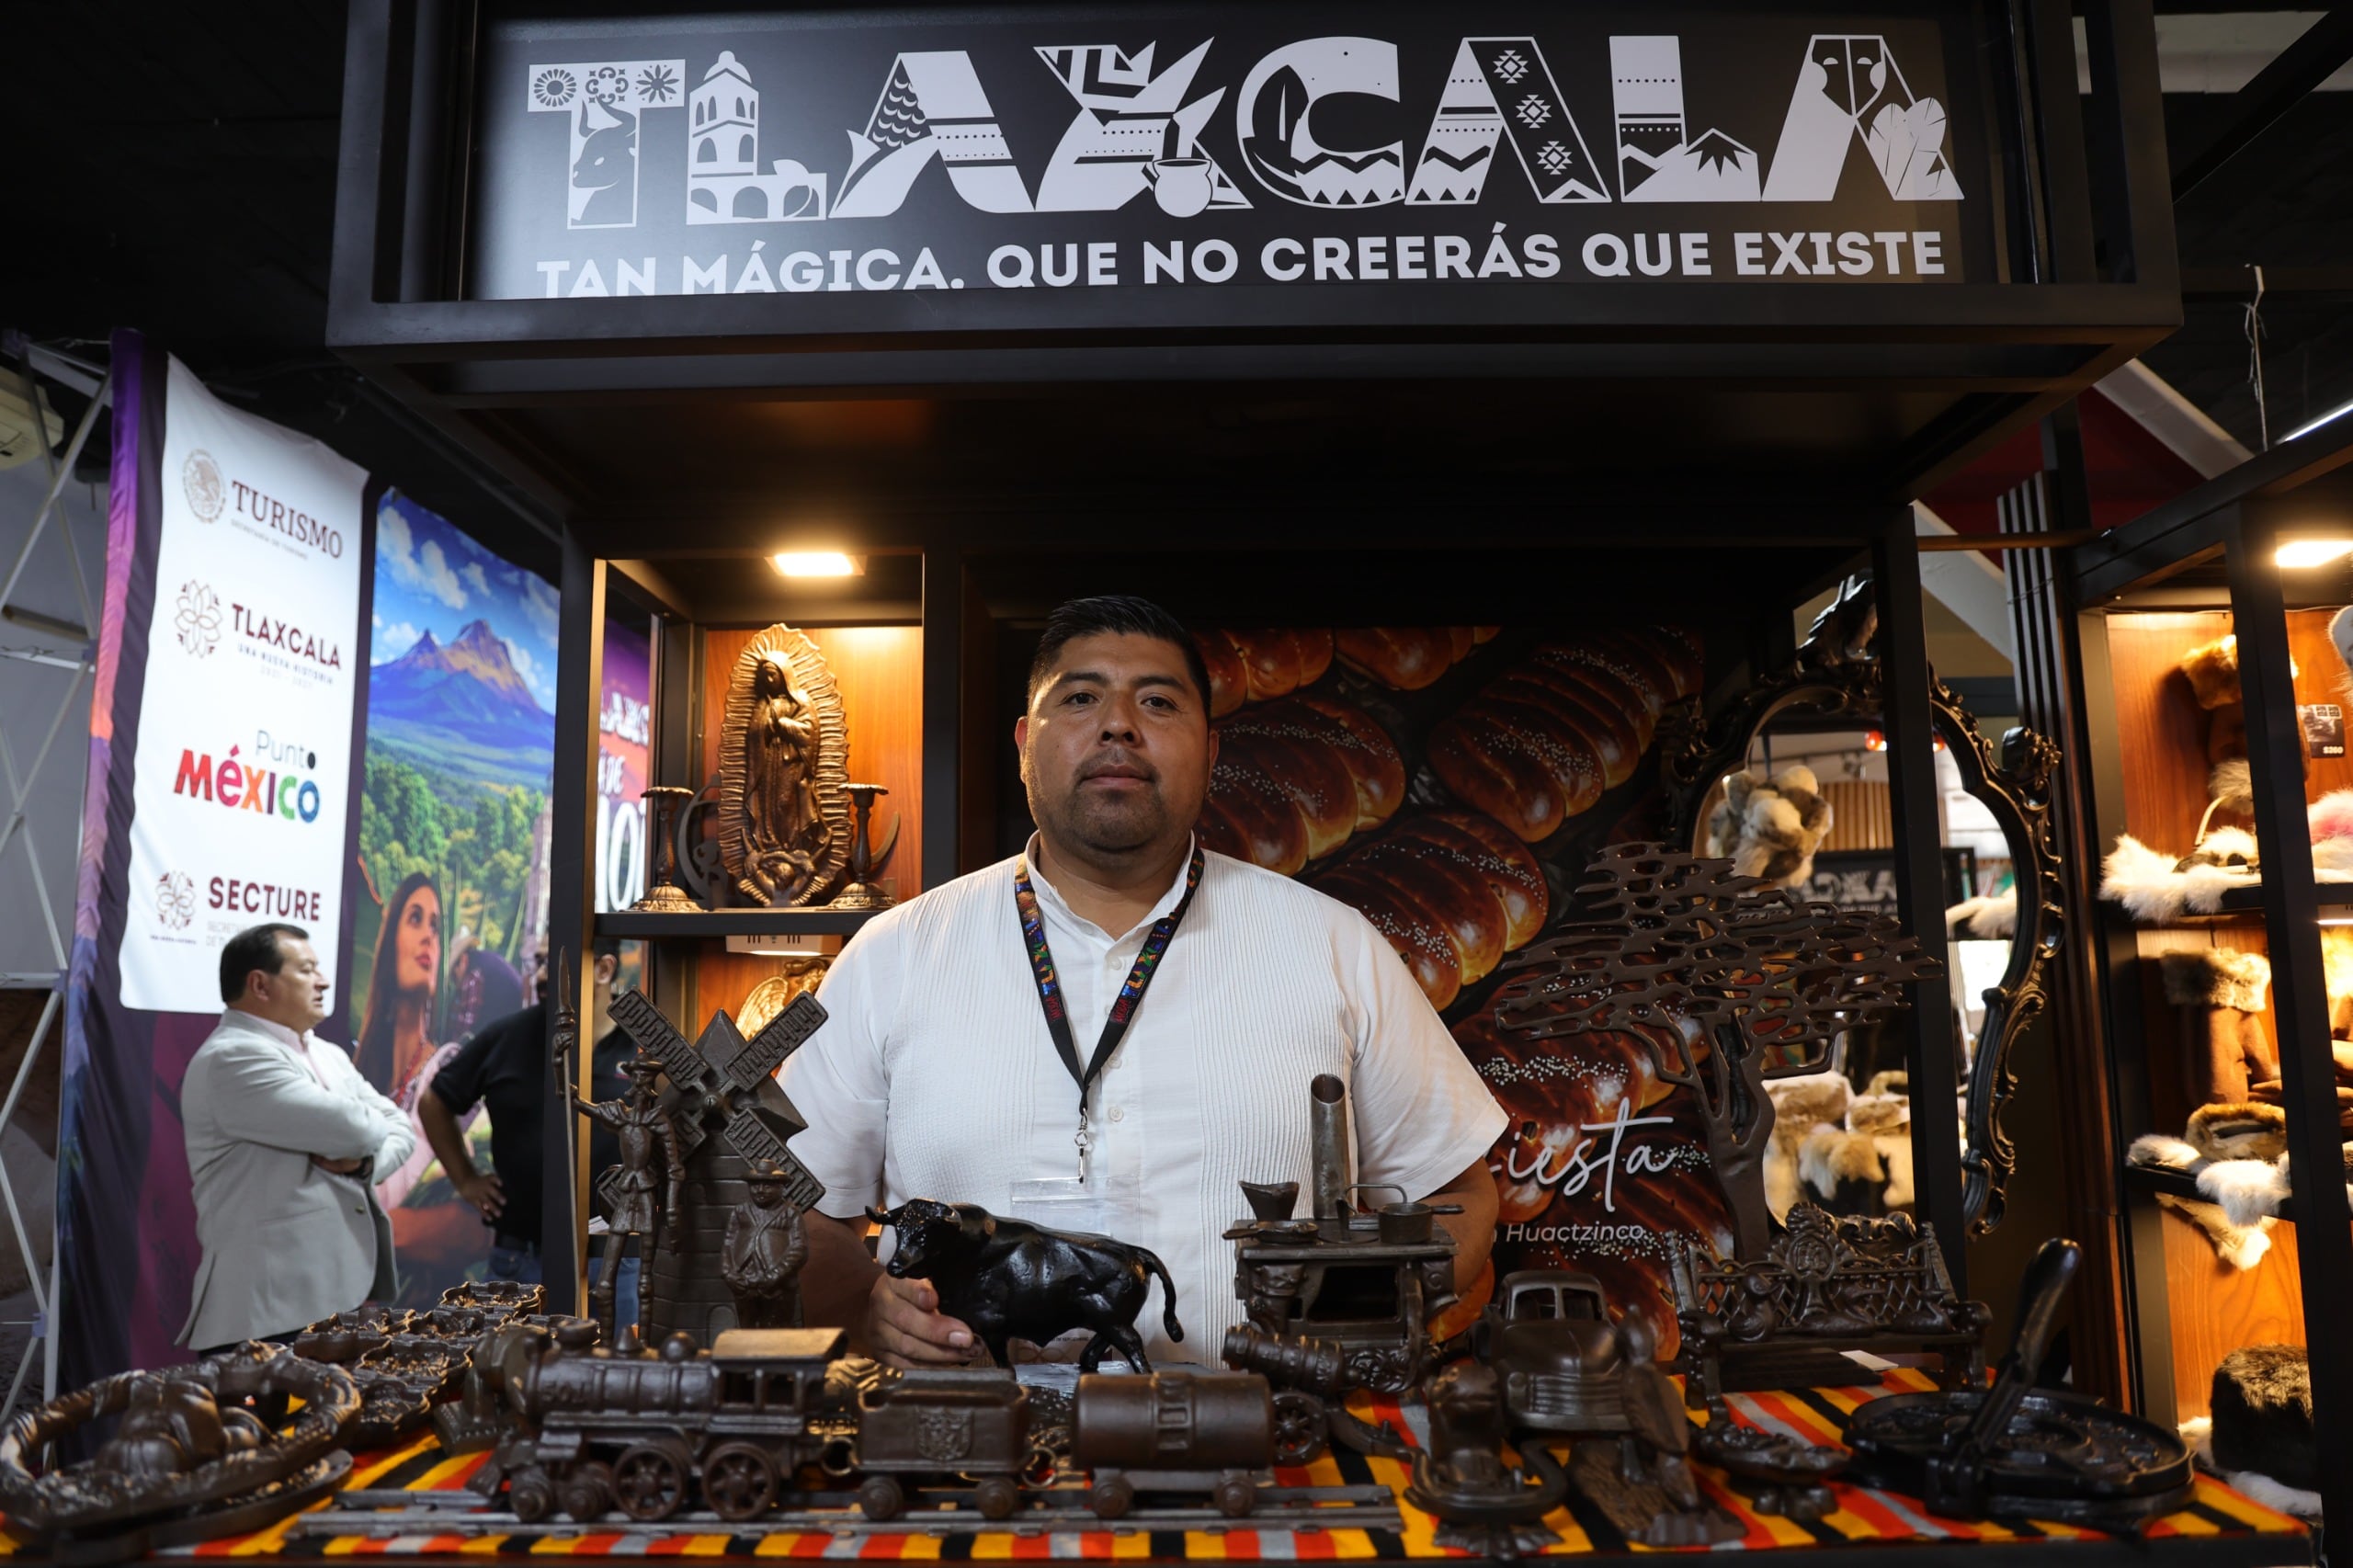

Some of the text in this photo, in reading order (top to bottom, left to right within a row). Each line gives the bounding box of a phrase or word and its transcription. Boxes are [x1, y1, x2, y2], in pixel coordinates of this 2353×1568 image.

[527, 35, 1965, 229] TLAXCALA
[536, 222, 1946, 298] TAN MÁGICA. QUE NO CREERÁS QUE EXISTE
[231, 480, 345, 559] TURISMO
[232, 603, 342, 670] TLAXCALA
[256, 730, 317, 770] Punto
[208, 876, 322, 922] SECTURE
[1489, 1096, 1675, 1212] iesta
[1506, 1221, 1643, 1243] Huactzinco
